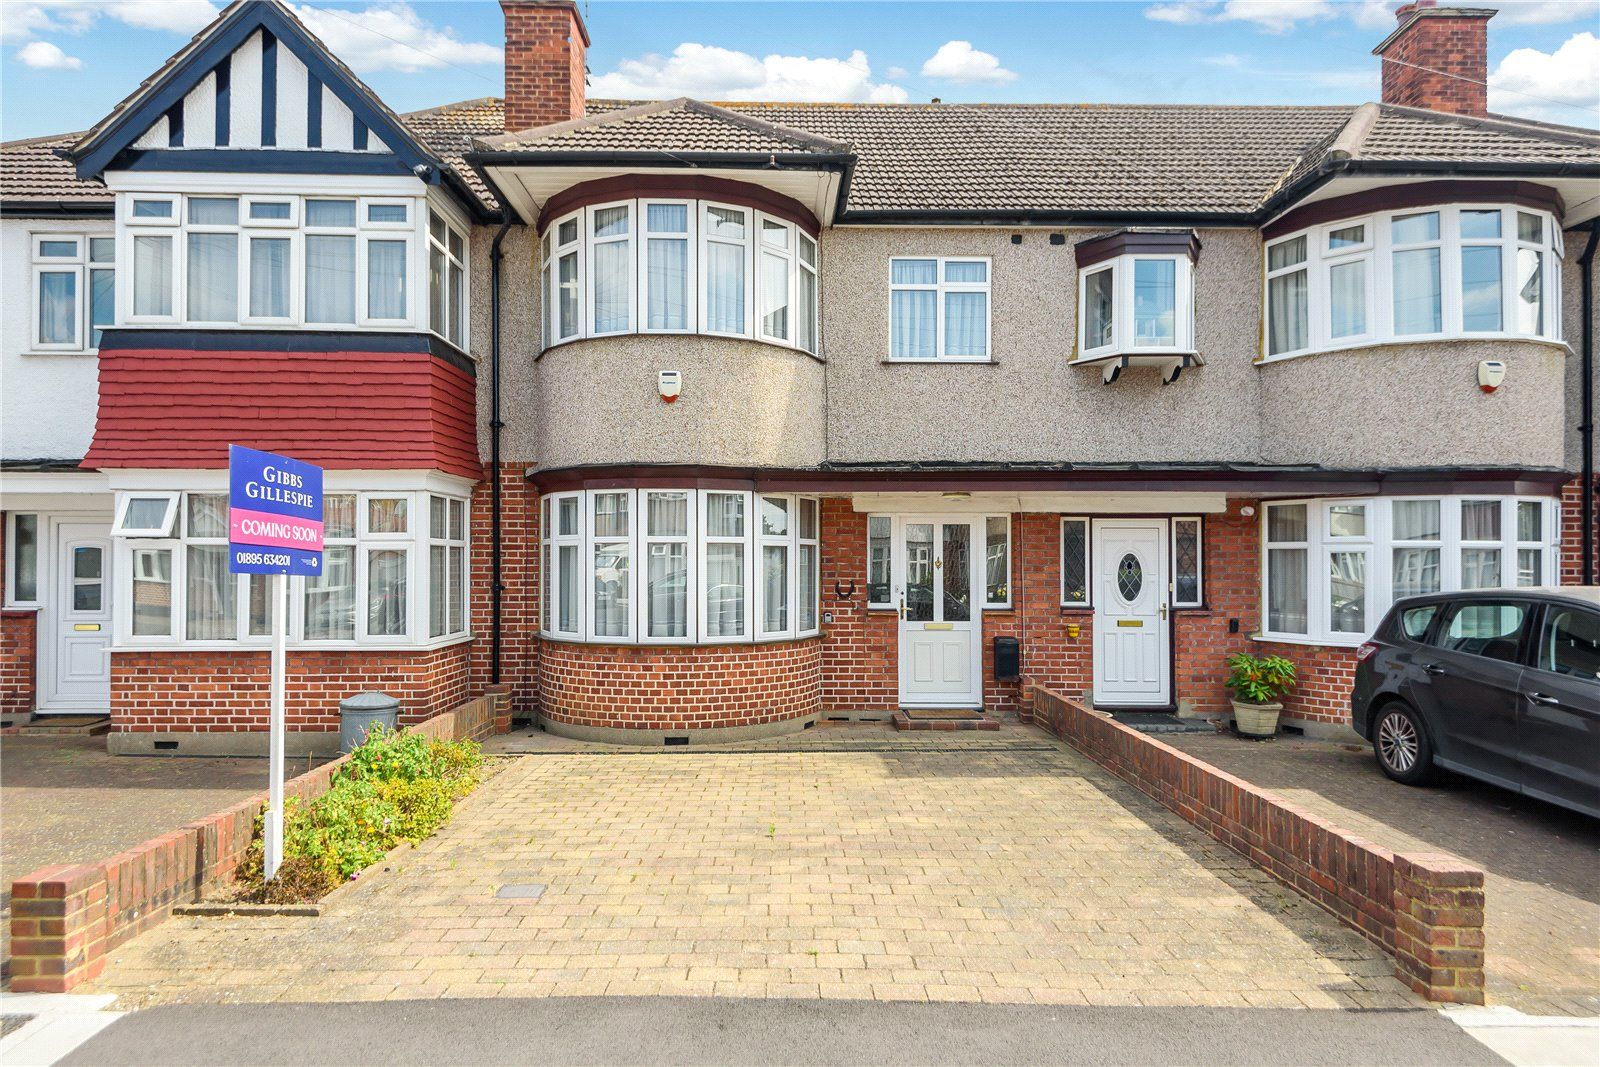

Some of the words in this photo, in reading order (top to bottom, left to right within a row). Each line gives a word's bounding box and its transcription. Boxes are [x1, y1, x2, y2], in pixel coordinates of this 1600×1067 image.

[263, 466, 303, 488] GIBBS
[245, 481, 313, 508] GILLESPIE
[241, 519, 291, 539] COMING
[292, 525, 317, 542] SOON
[236, 552, 263, 565] 01895
[263, 553, 291, 566] 634201
